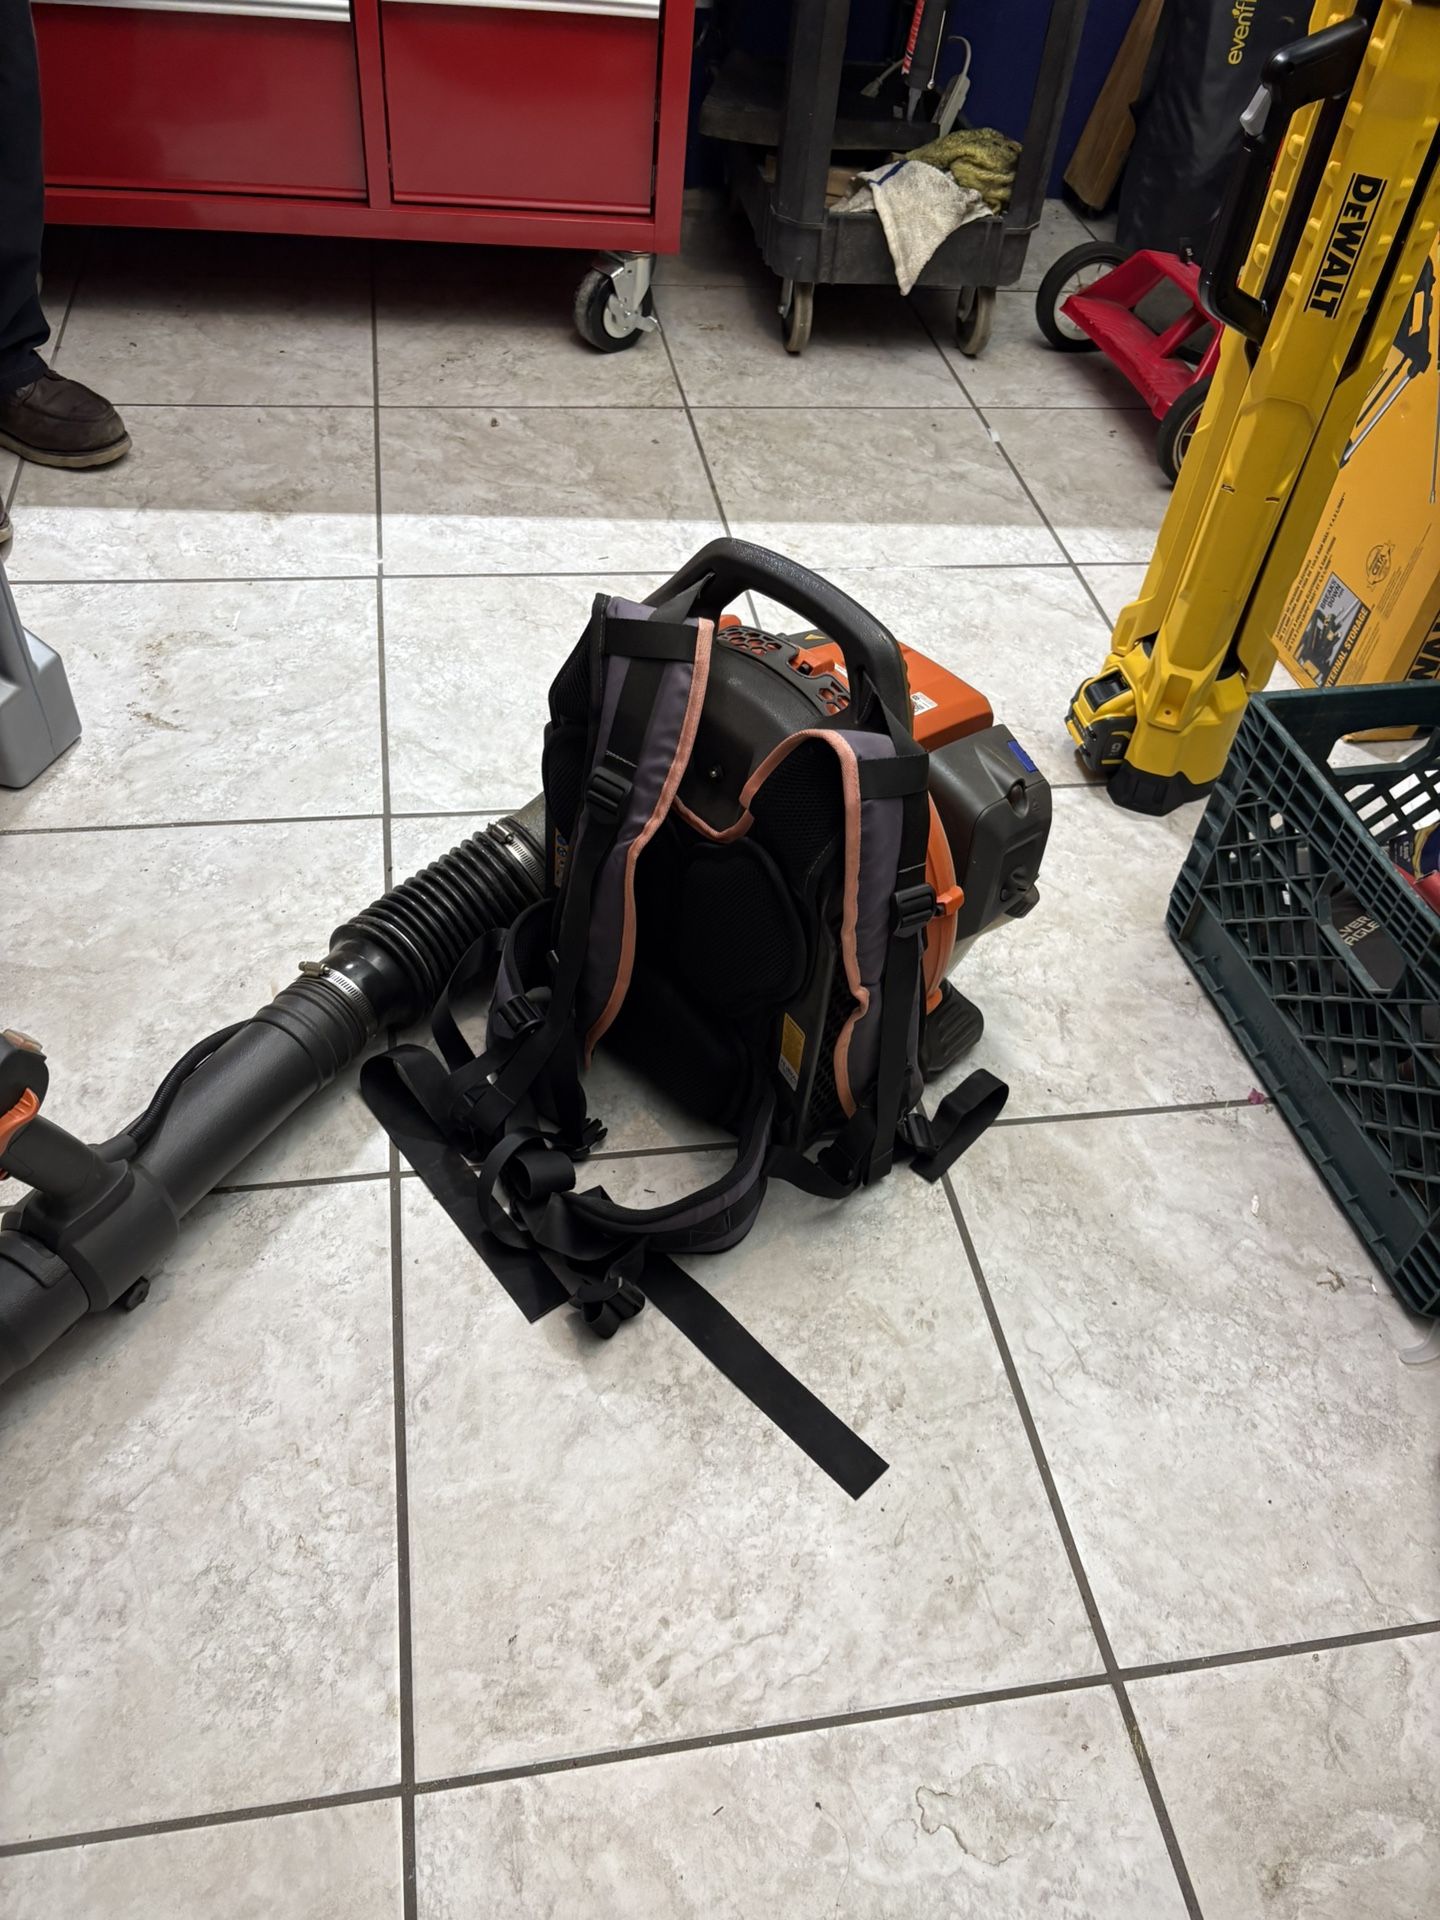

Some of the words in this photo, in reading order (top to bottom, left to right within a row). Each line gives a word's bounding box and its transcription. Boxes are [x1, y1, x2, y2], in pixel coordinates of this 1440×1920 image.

[1309, 173, 1383, 318] DEWALT
[1327, 584, 1342, 608] DOWN
[1344, 607, 1368, 649] STORAGE
